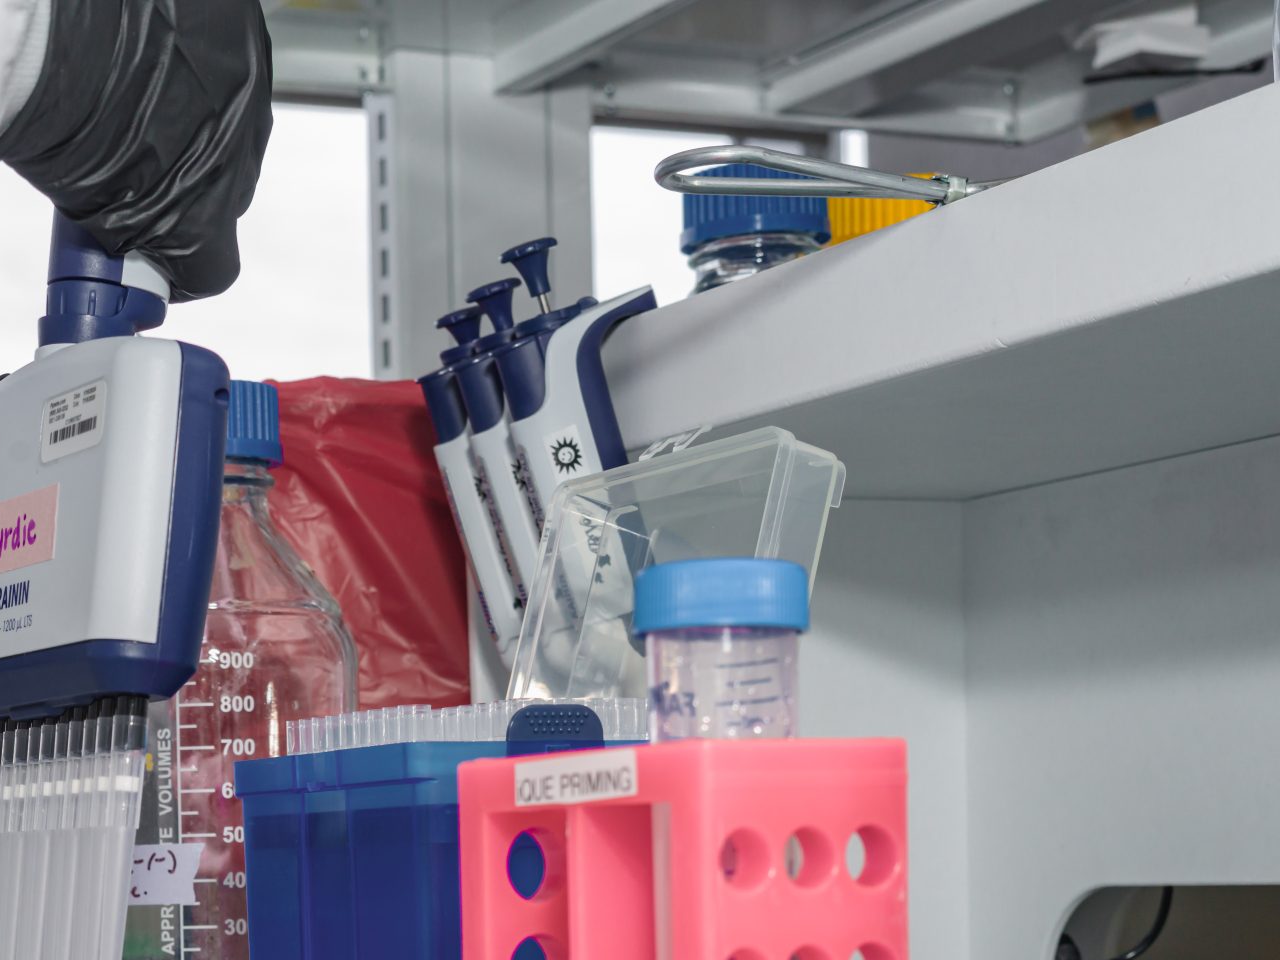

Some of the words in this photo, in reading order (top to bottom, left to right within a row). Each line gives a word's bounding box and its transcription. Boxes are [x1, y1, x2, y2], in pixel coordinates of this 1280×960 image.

[23, 614, 32, 628] LTS
[220, 651, 254, 669] 900
[220, 695, 255, 712] 800
[220, 739, 255, 756] 700
[157, 728, 173, 816] VOLUMES
[559, 766, 631, 799] PRIMING
[223, 826, 244, 843] 50
[223, 871, 246, 888] 40
[224, 918, 247, 935] 30
